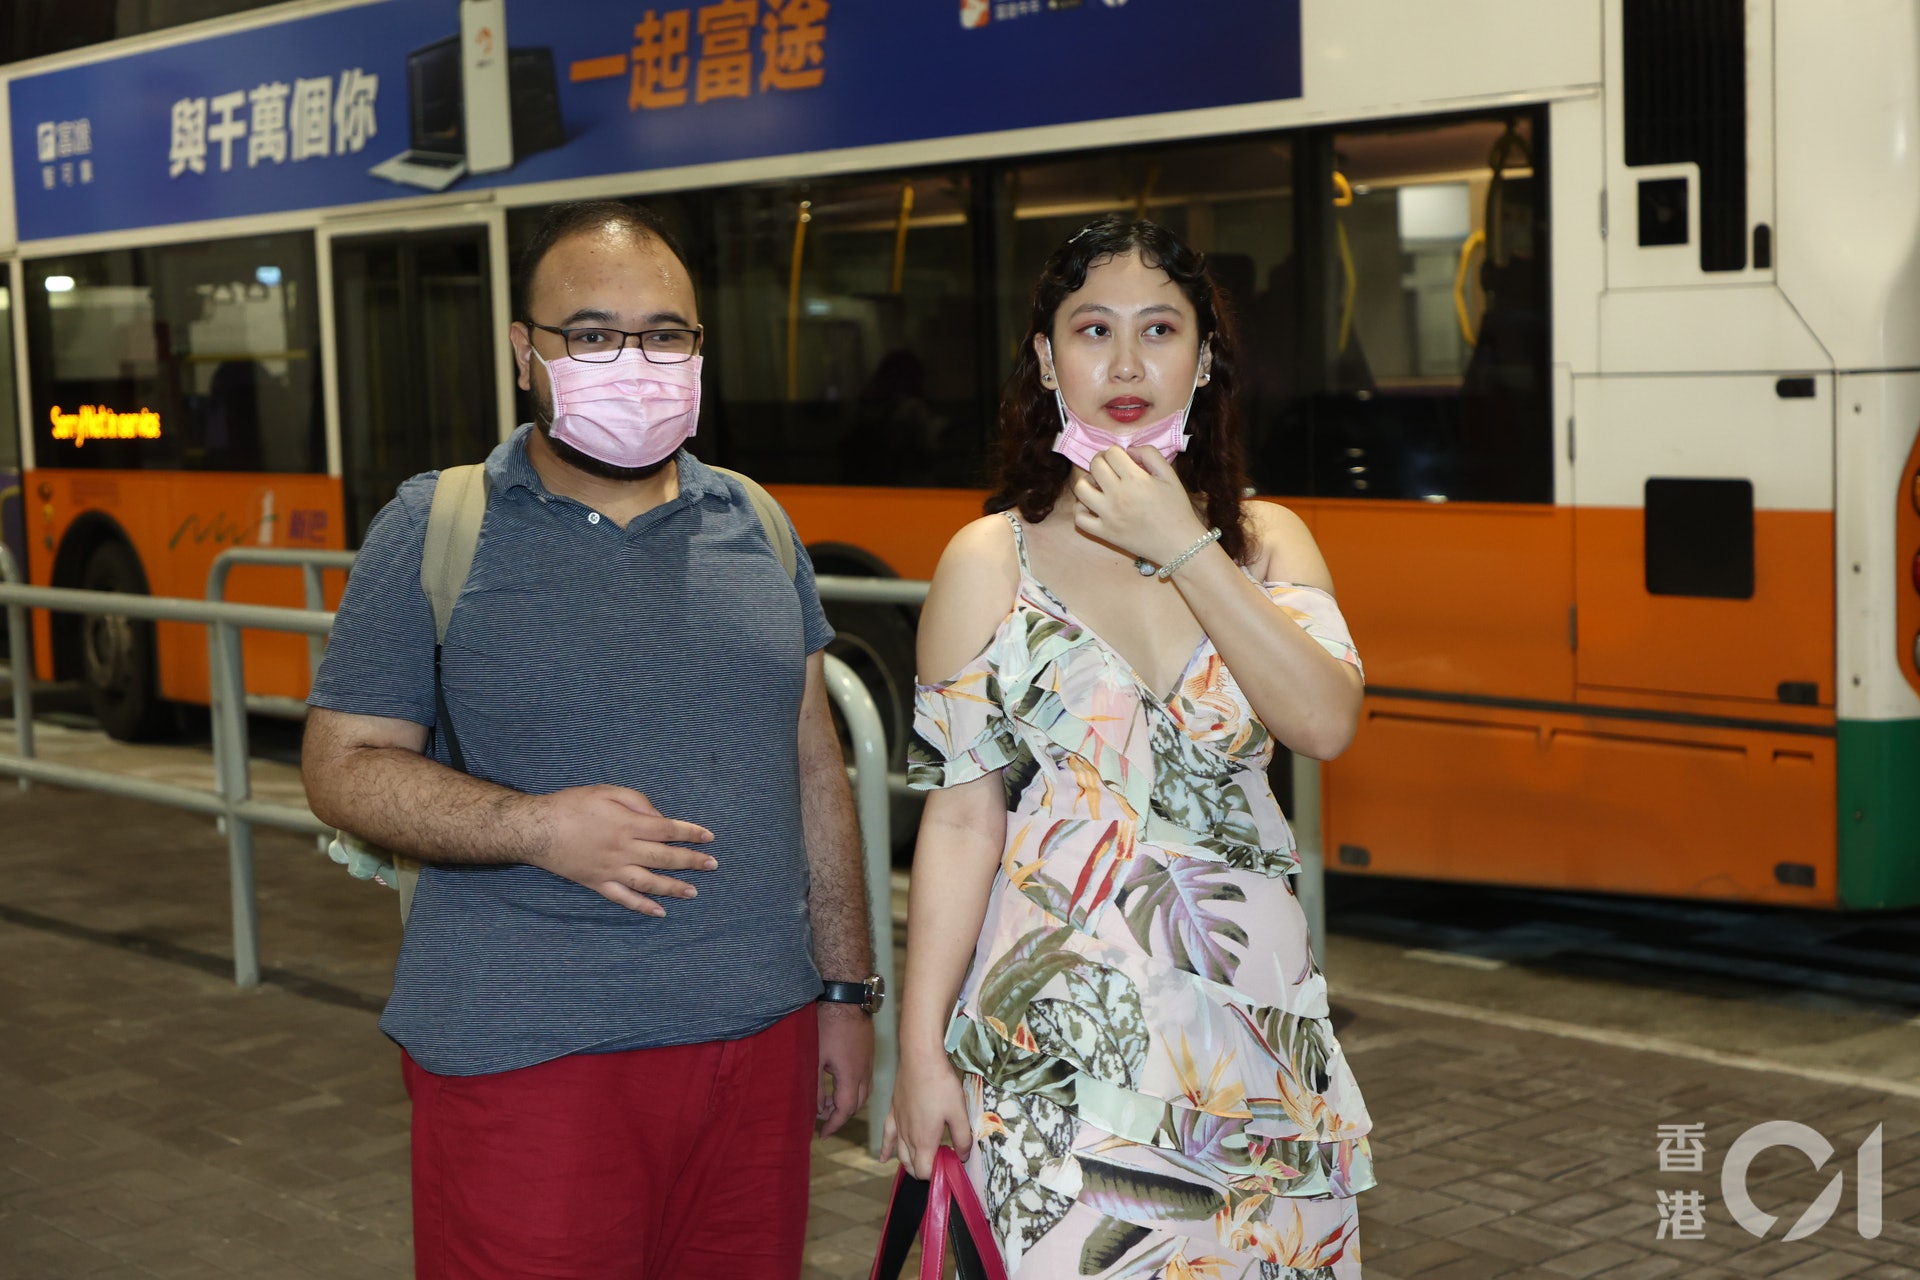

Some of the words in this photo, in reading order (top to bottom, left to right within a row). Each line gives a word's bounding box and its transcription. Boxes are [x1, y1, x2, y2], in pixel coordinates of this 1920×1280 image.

[568, 0, 832, 112] 一起富途
[169, 66, 379, 180] 與千萬個你
